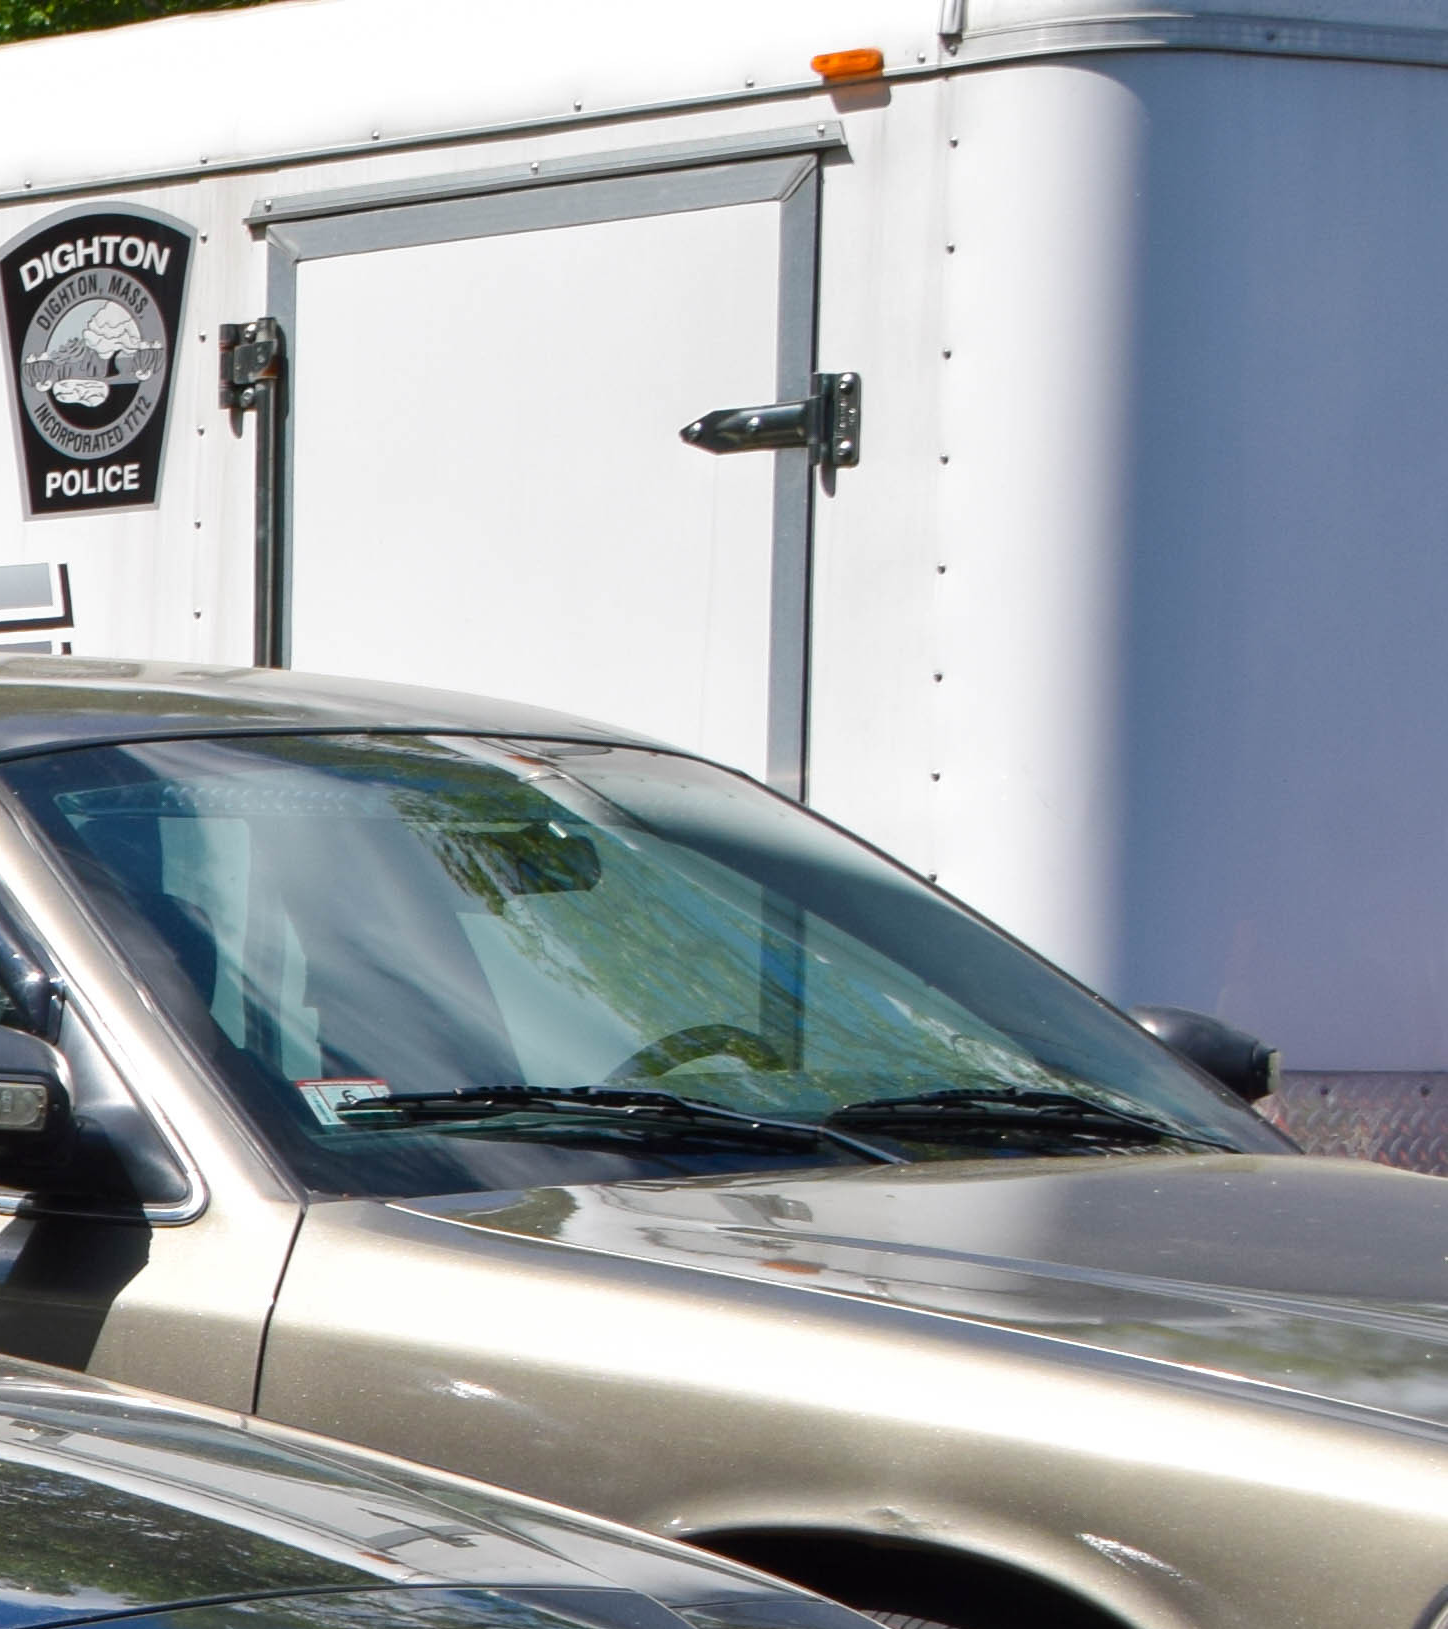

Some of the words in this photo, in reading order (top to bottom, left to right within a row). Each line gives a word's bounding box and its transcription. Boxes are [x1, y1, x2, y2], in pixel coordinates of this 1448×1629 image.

[19, 235, 170, 292] DIGHTON
[108, 278, 147, 320] MASS.
[34, 402, 124, 453] INCORPORATED
[123, 395, 153, 435] 1712
[45, 463, 140, 498] POLICE
